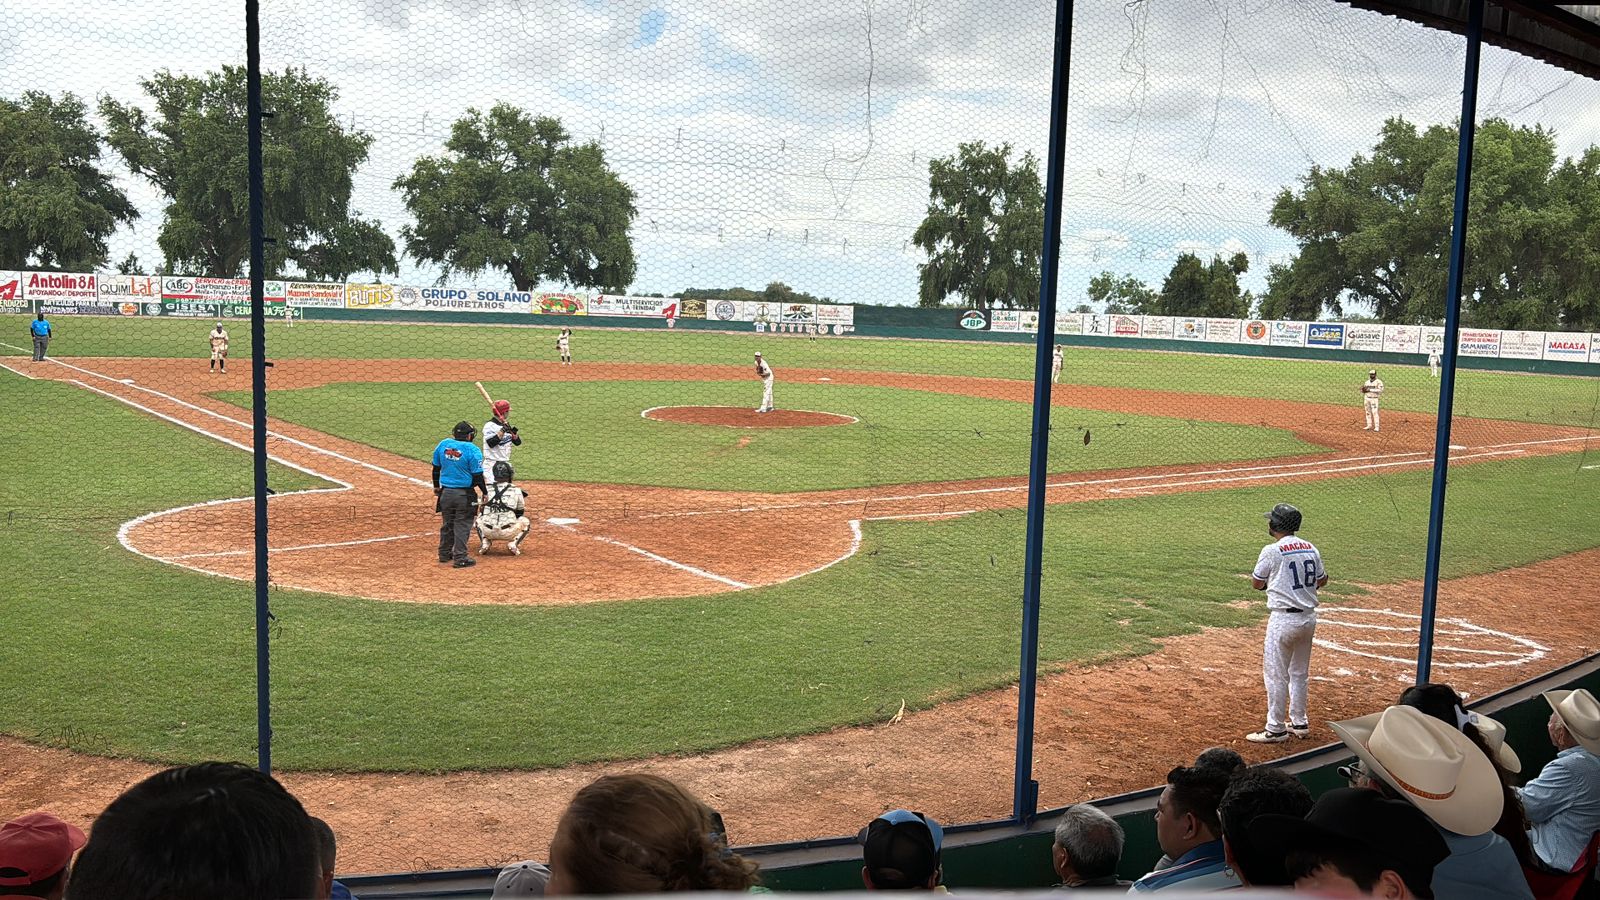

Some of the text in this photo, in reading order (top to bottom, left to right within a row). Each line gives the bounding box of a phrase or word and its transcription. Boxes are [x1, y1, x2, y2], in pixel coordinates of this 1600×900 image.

[29, 273, 77, 289] Antolin
[170, 281, 189, 290] ABC
[421, 288, 531, 303] GRUPO SOLANO
[165, 303, 215, 311] GISESA
[425, 299, 505, 309] POLIURETANOS
[616, 299, 663, 307] MULTISERVICIOS
[1347, 331, 1380, 340] Guasave
[1548, 342, 1586, 350] MACASA
[1289, 560, 1316, 590] 18
